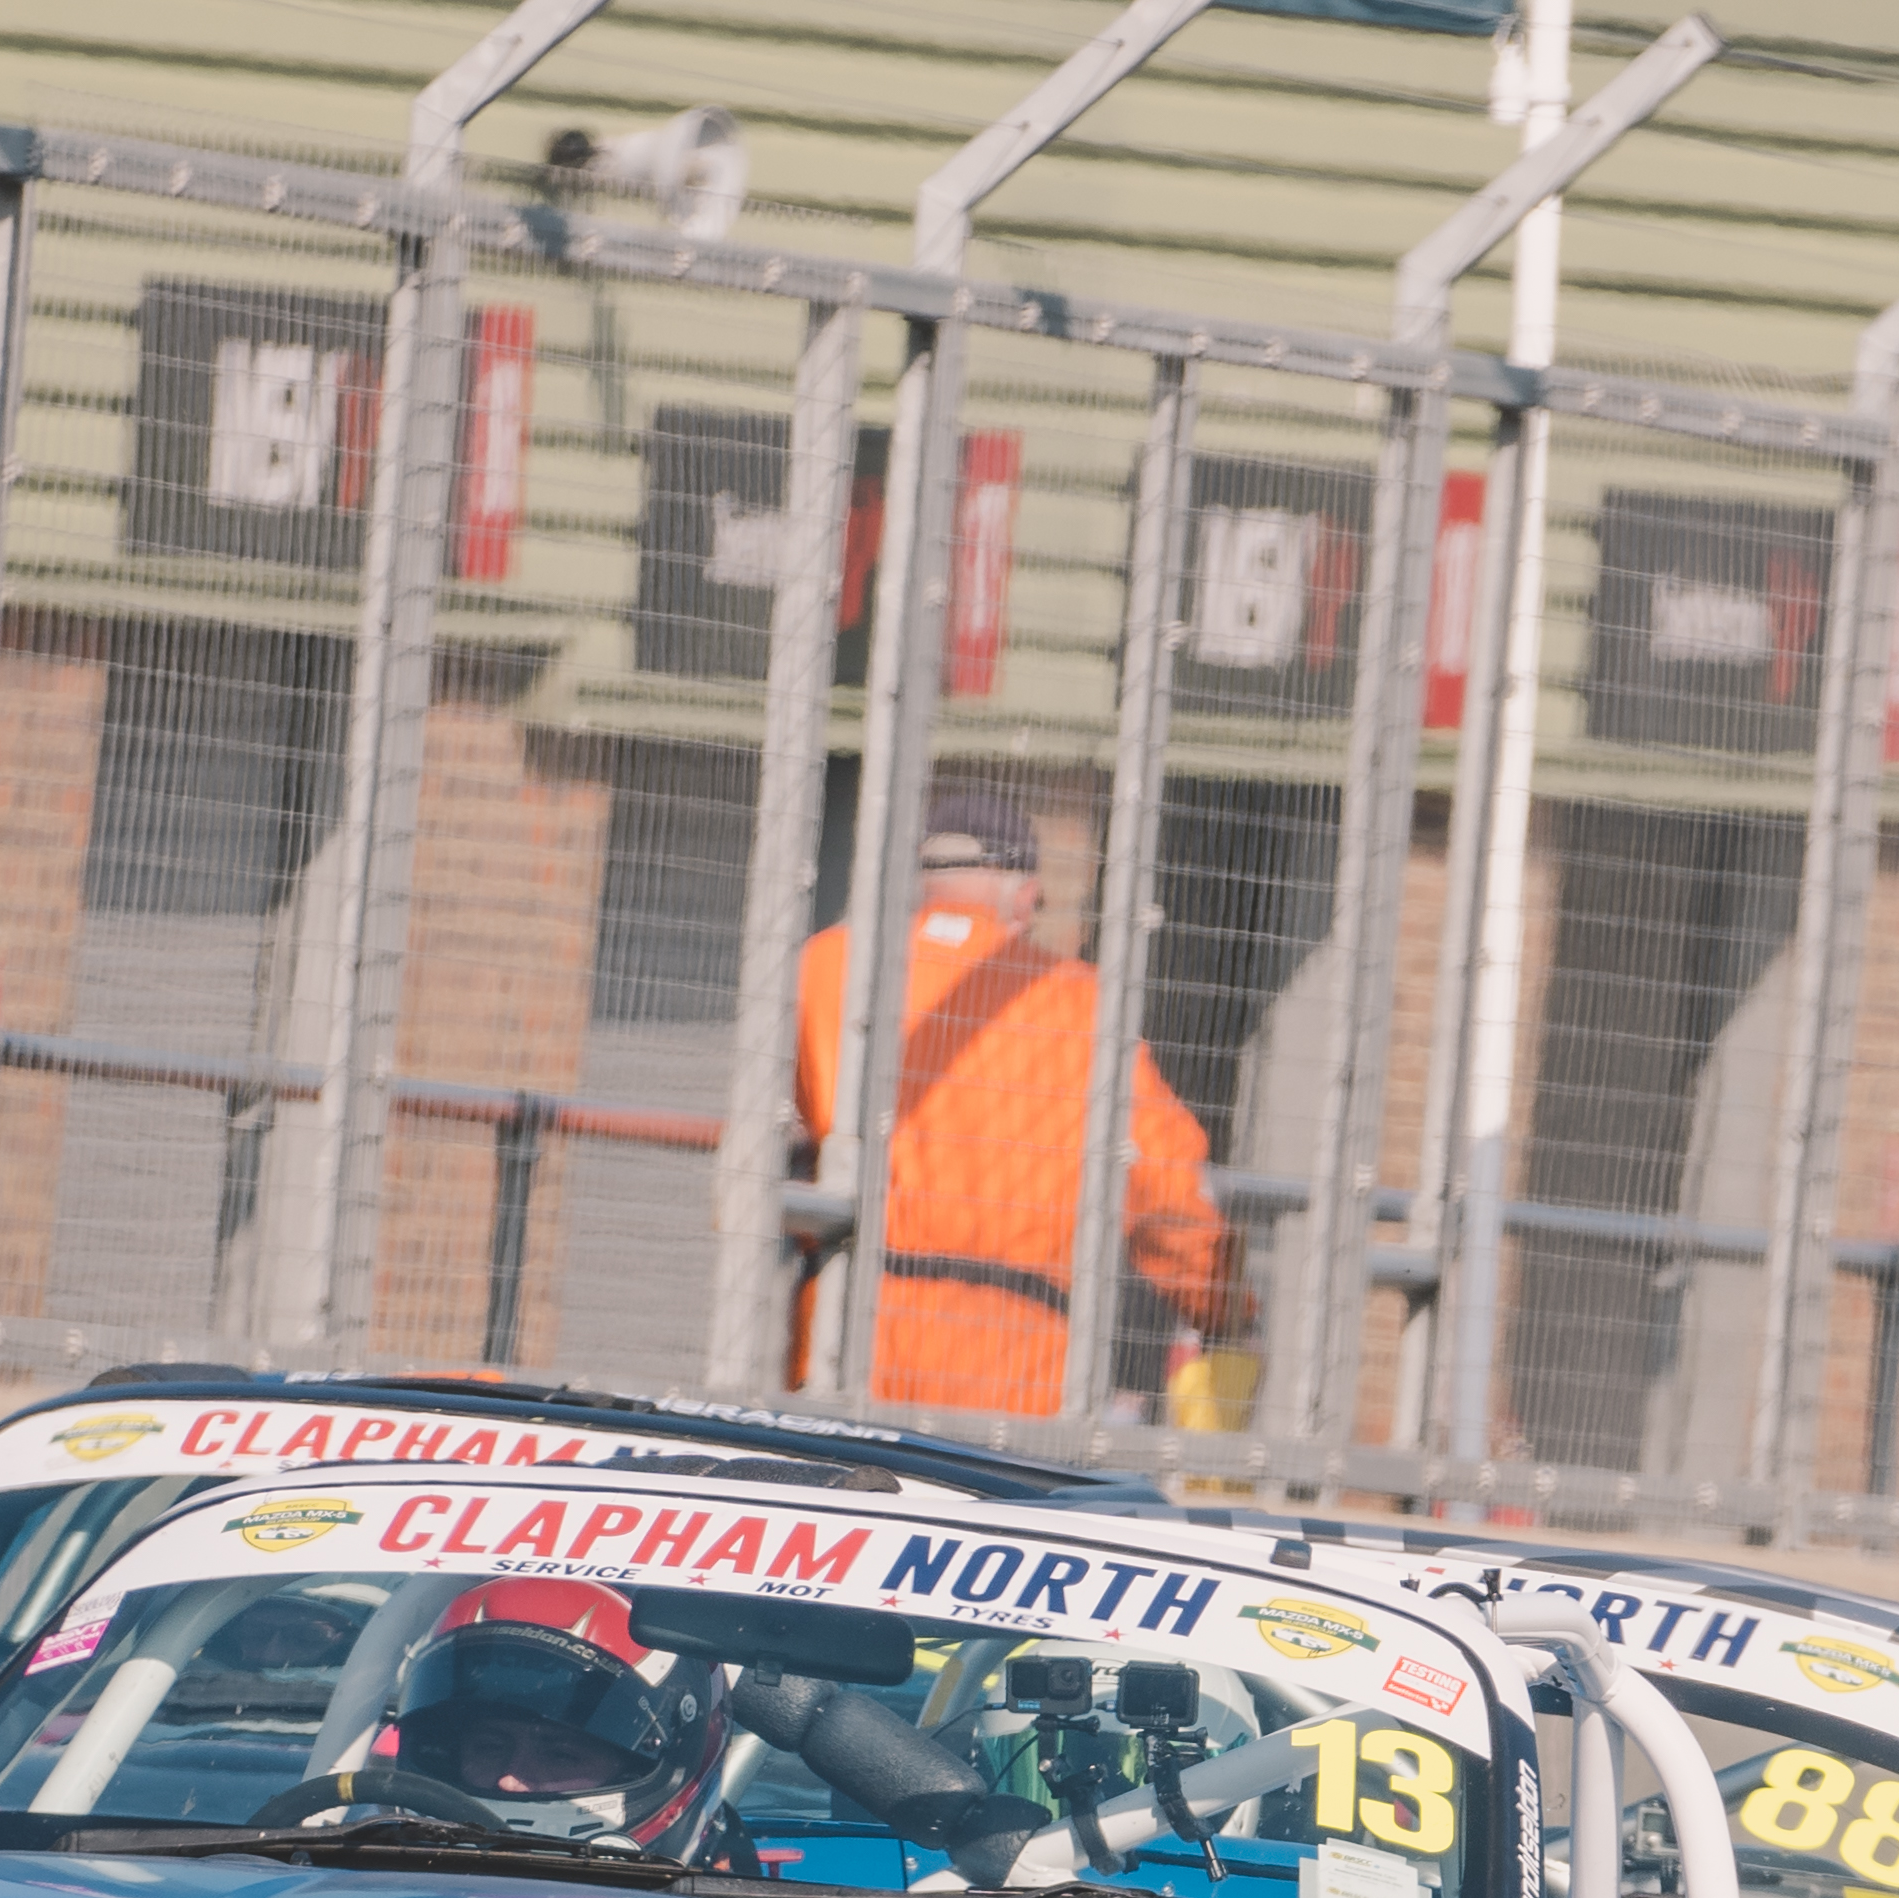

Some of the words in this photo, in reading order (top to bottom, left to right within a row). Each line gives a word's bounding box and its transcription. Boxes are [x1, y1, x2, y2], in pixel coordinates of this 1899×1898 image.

[179, 1409, 588, 1466] CLAPHAM
[242, 1511, 302, 1525] MAZDA
[305, 1510, 348, 1519] MX-5
[378, 1493, 874, 1585] CLAPHAM
[879, 1533, 1222, 1637] NORTH
[493, 1558, 642, 1581] SERVICE
[756, 1579, 835, 1602] MOT
[949, 1603, 1057, 1632] TYRES
[1258, 1607, 1319, 1626] MAZDA
[1323, 1617, 1365, 1641] MX-5
[1399, 1657, 1462, 1692] TESTING
[1290, 1719, 1455, 1854] 13
